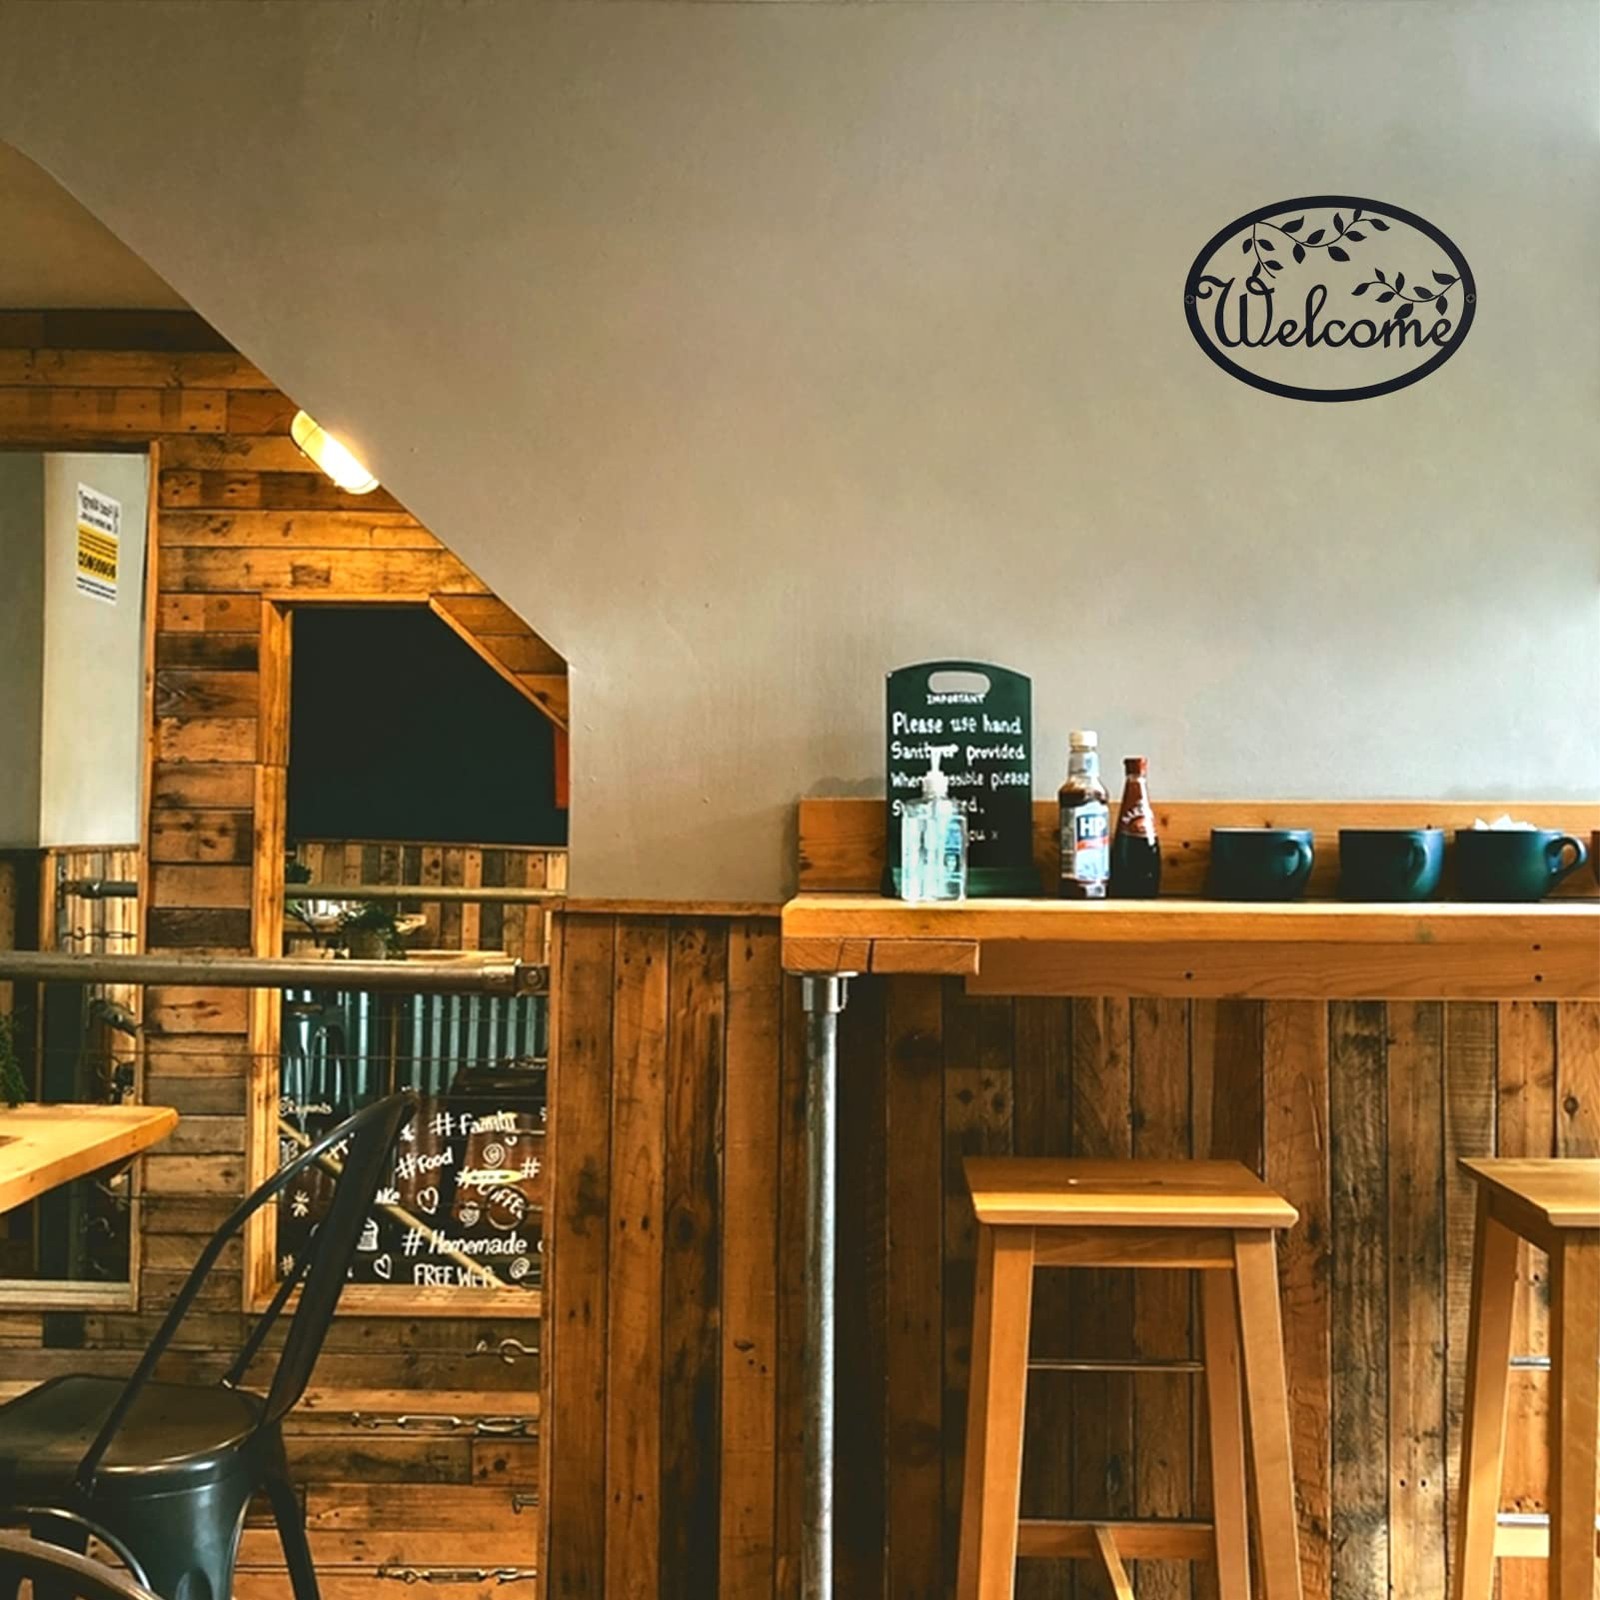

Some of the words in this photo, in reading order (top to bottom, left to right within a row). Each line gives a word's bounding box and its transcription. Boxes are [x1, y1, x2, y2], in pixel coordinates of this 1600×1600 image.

[1196, 275, 1452, 348] Welcome
[926, 693, 986, 706] IMPORTANT
[892, 711, 943, 735] Please
[949, 716, 977, 733] use
[982, 713, 1022, 735] hand
[965, 743, 1026, 767] provided
[946, 771, 984, 786] ssible
[990, 771, 1030, 791] please
[1079, 815, 1108, 837] HP
